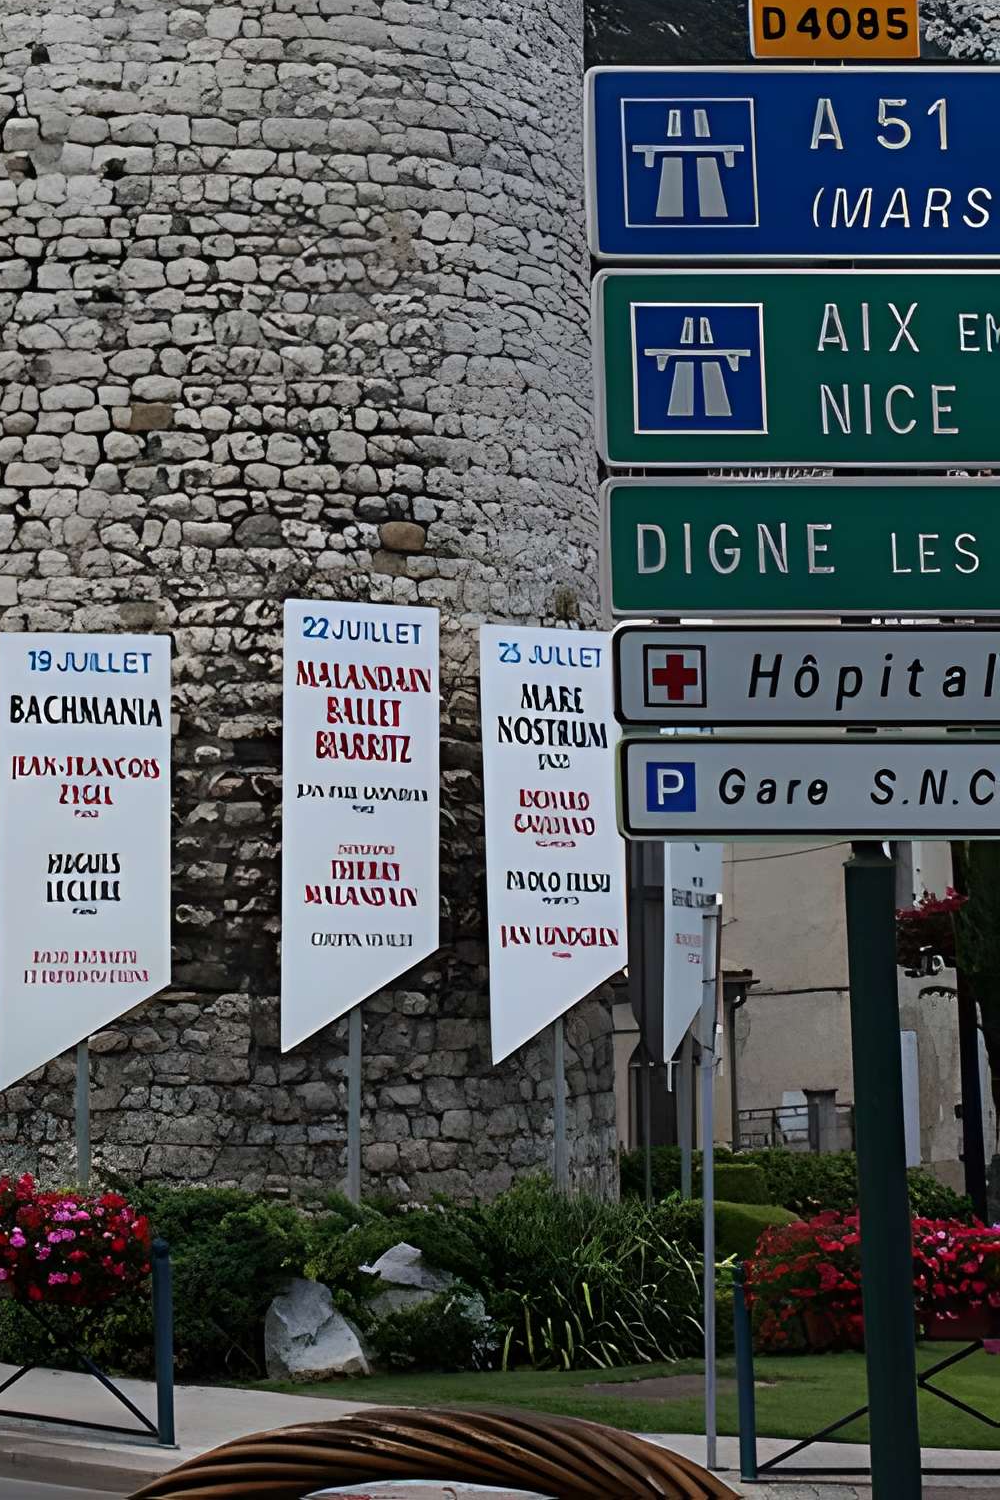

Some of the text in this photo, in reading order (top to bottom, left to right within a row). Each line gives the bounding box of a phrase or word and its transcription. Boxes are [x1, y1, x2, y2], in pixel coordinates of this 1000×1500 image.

[810, 98, 948, 150] A 51
[818, 303, 920, 352] AIX
[820, 384, 959, 435] NICE
[637, 523, 980, 574] DIGNE LES
[303, 616, 422, 645] 22 JUILLET
[28, 650, 152, 674] 19 JUILLET
[748, 652, 997, 711] Hôpital
[10, 694, 163, 727] BACHMANIA
[326, 696, 402, 727] BALLET
[315, 730, 412, 764] BIARRITZ
[497, 716, 608, 749] NOSTRUM
[718, 767, 829, 806] Gare
